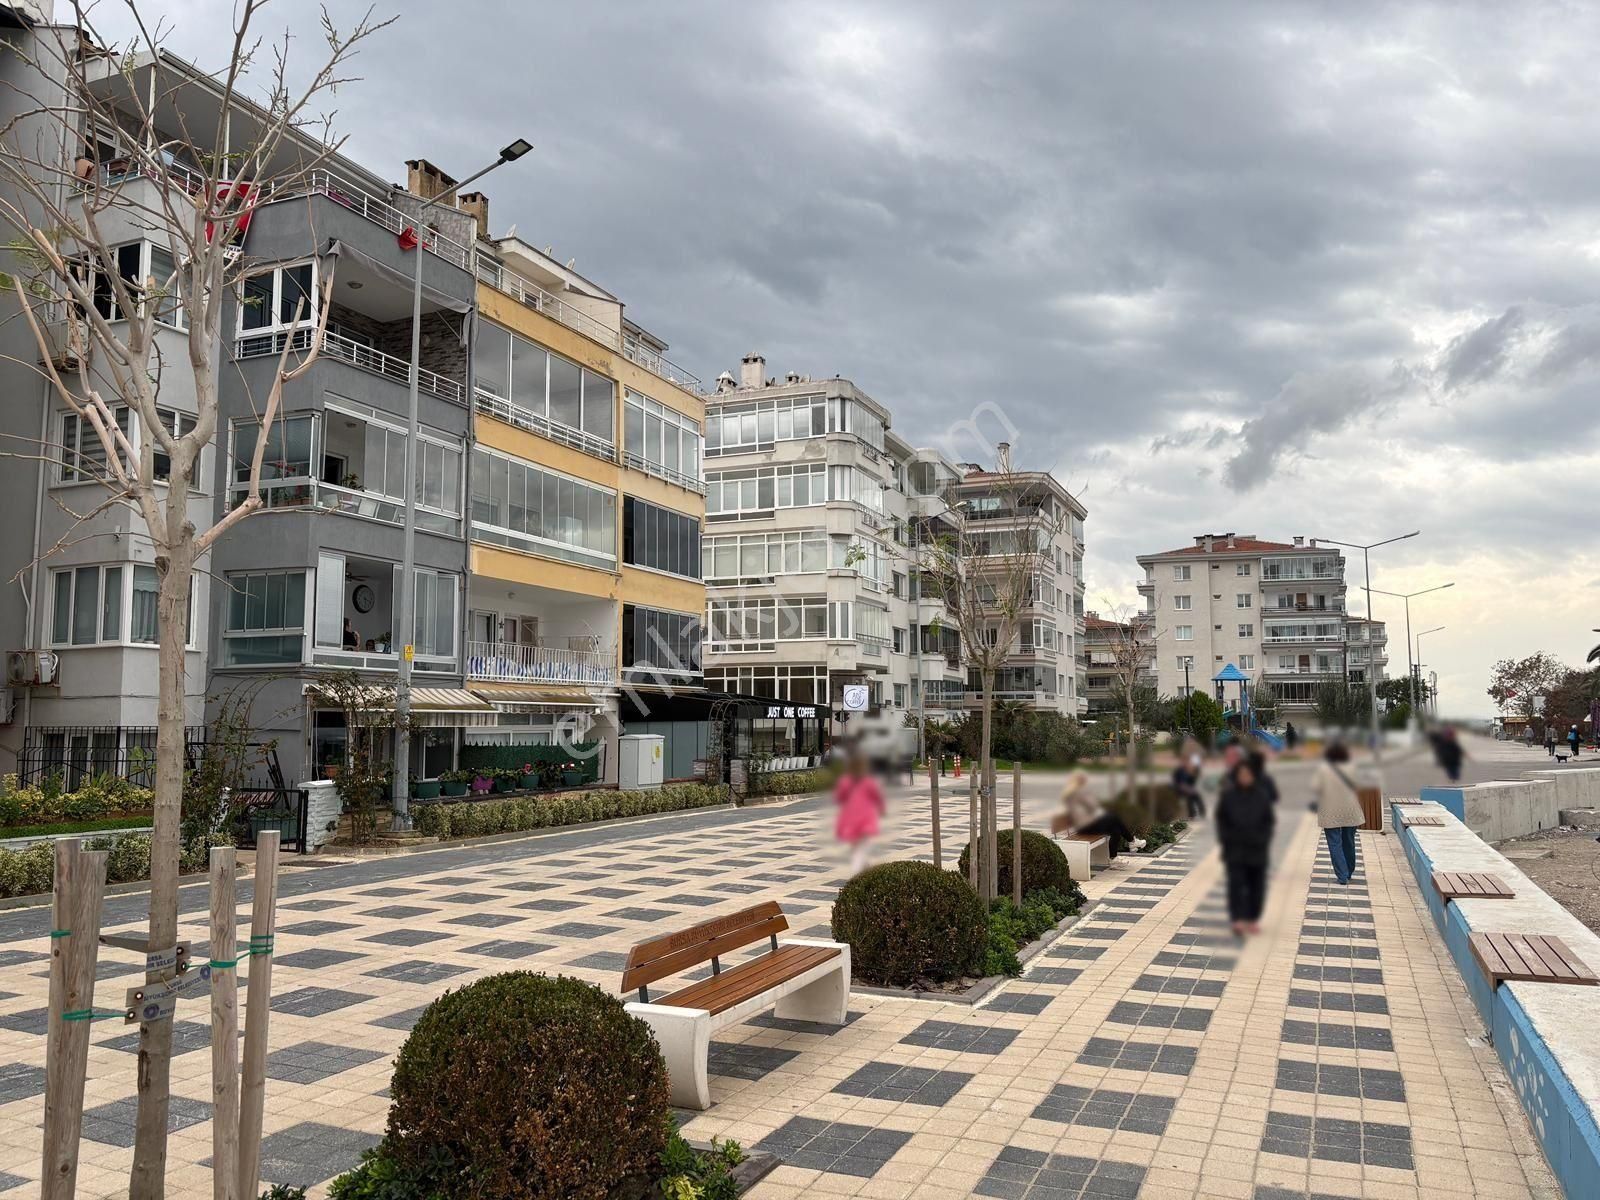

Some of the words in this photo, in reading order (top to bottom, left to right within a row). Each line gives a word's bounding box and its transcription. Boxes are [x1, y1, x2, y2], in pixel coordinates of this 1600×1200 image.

[767, 706, 781, 718] JUST
[783, 706, 795, 718] ONE
[797, 706, 816, 718] COFFEE
